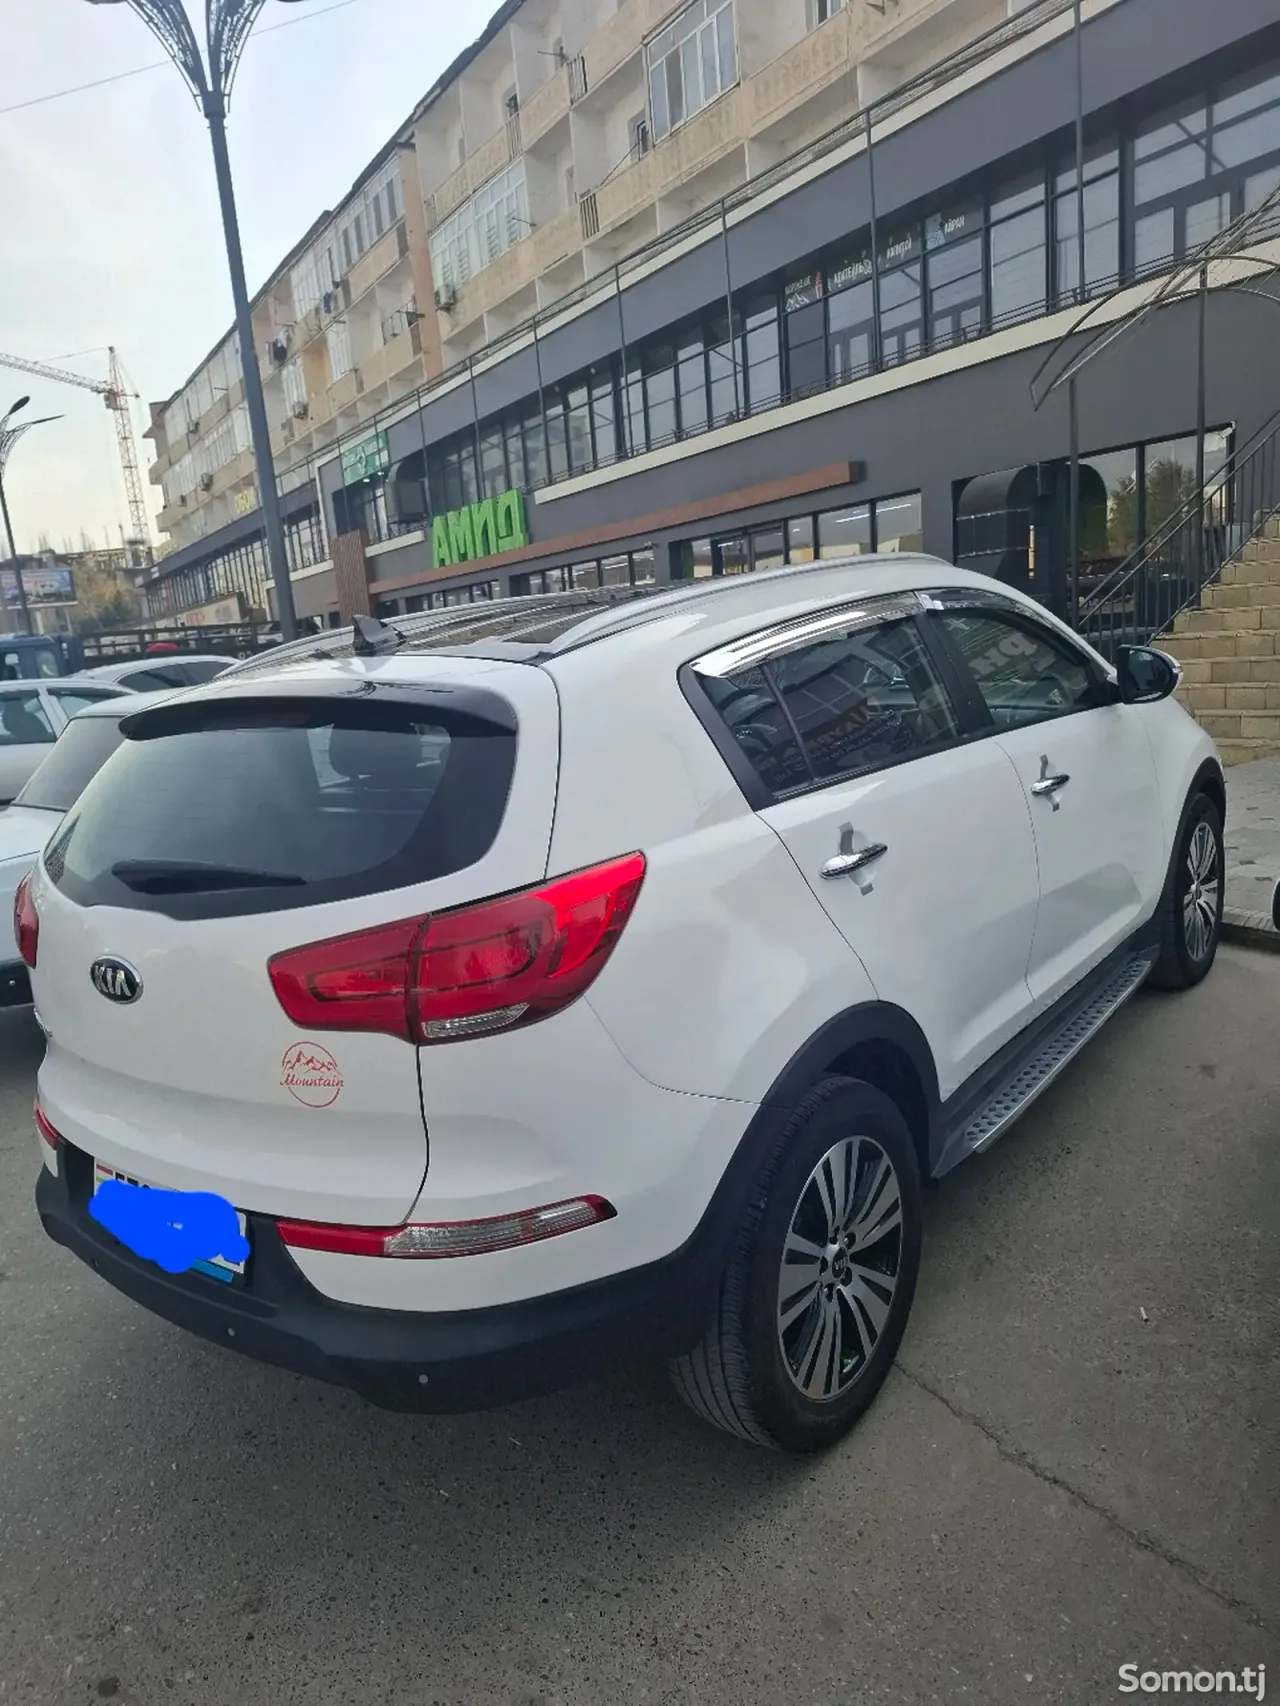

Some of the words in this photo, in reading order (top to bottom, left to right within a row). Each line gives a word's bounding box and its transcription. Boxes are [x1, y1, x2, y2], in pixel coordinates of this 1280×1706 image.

[432, 488, 530, 568] АМИД
[94, 965, 133, 998] KIA
[279, 1071, 345, 1089] Mountain
